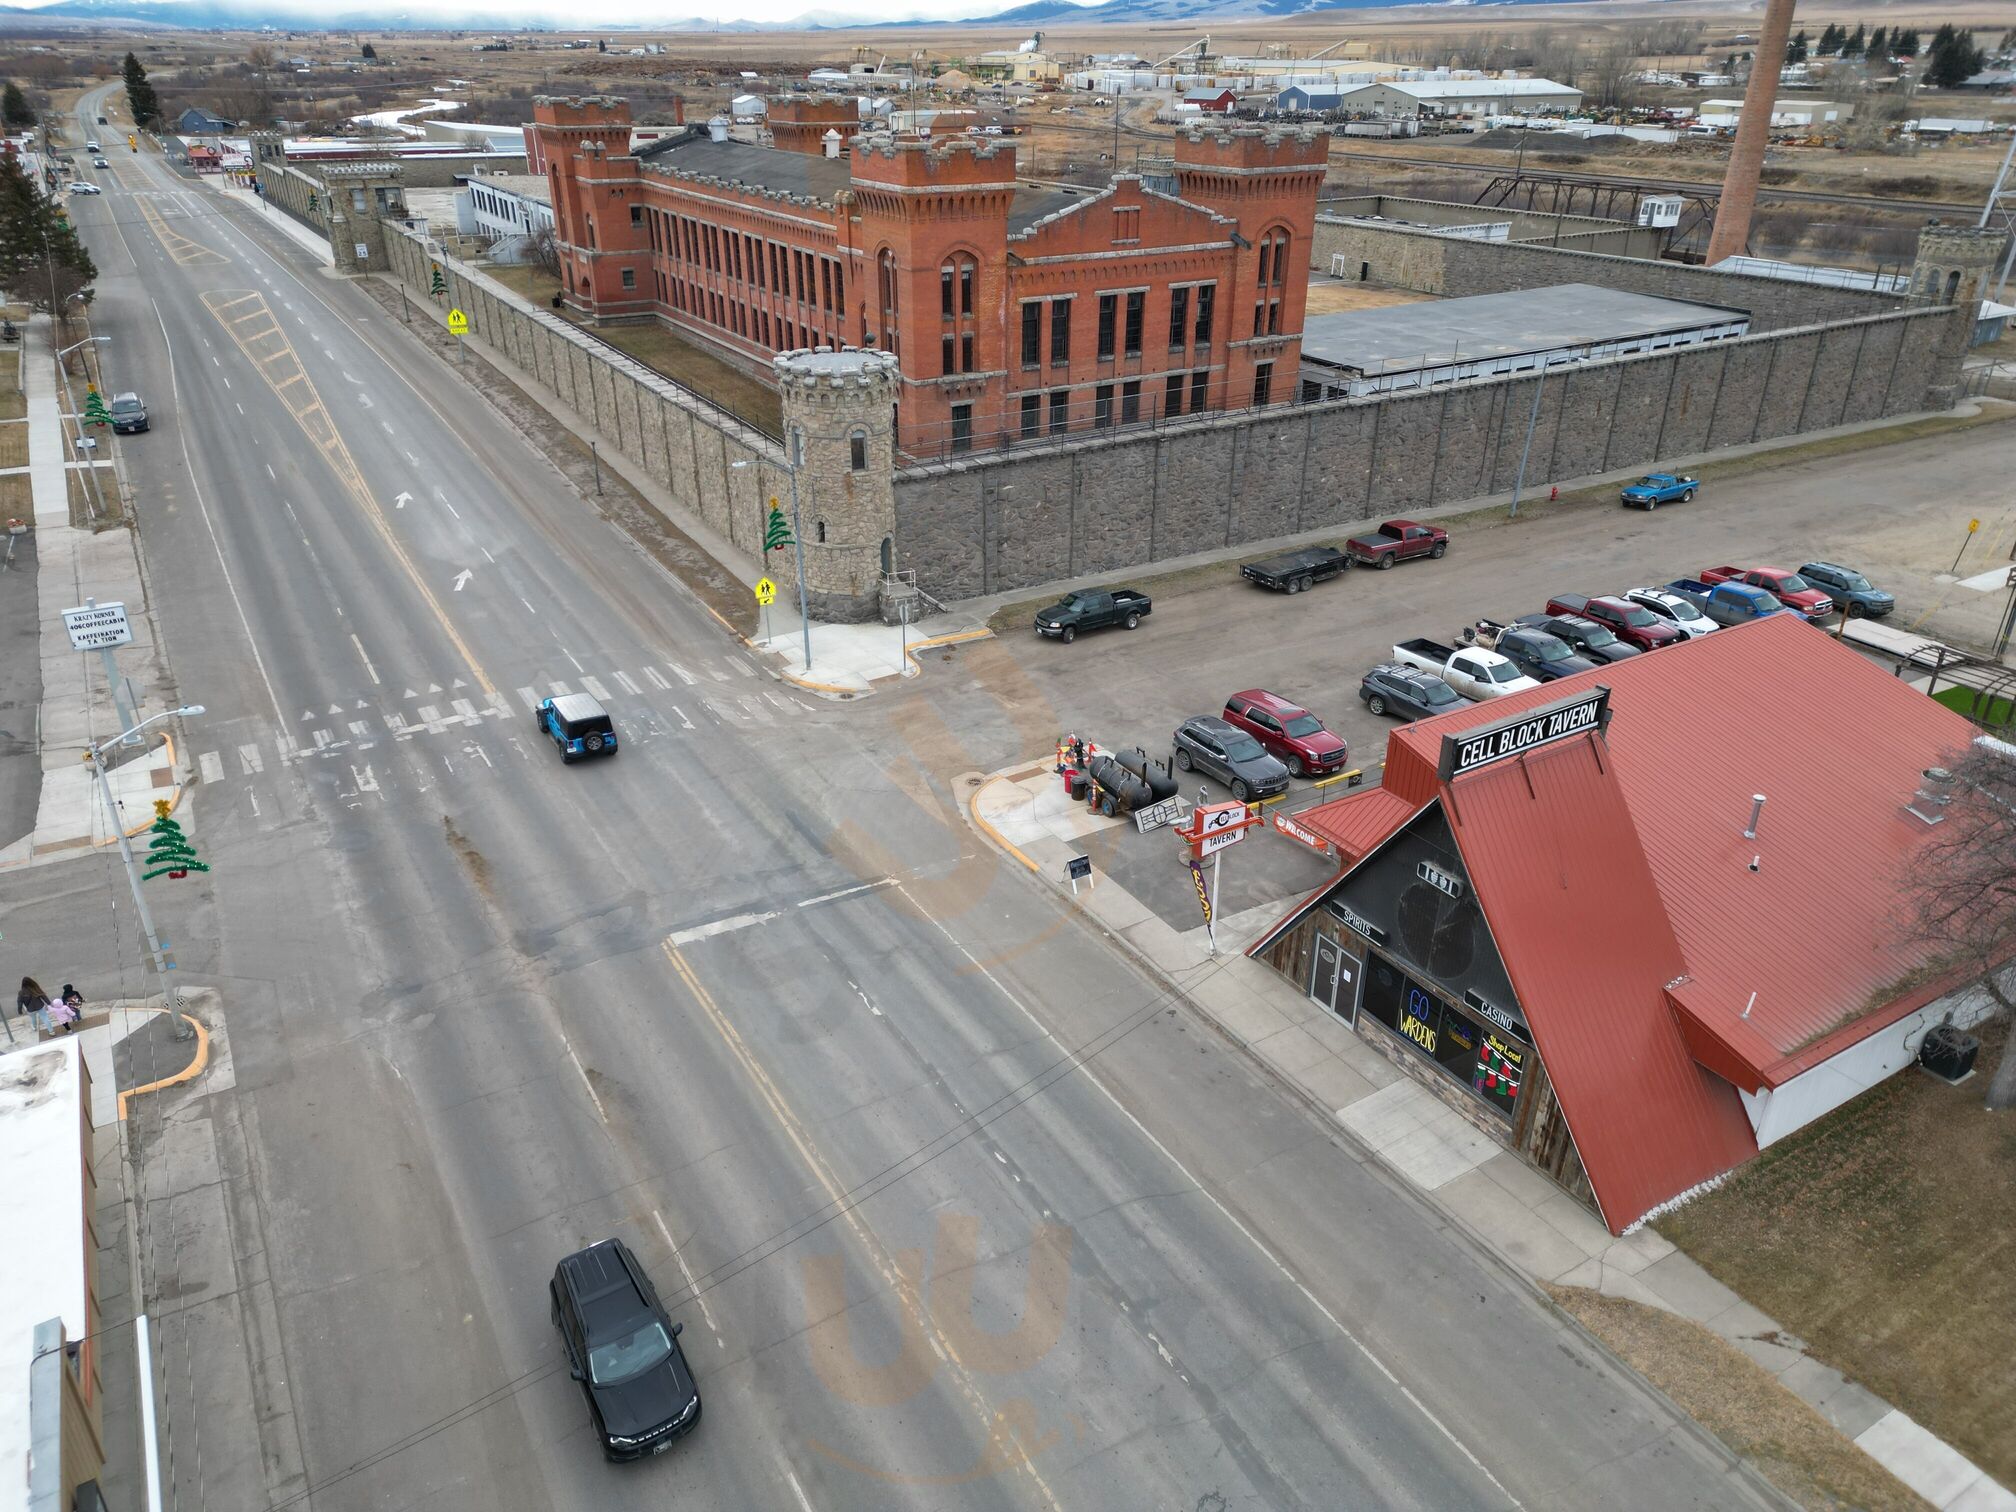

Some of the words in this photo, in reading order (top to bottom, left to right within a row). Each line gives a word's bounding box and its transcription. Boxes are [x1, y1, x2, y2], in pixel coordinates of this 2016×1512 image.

[73, 613, 94, 622] KRAZY
[94, 610, 116, 619] KORNER
[77, 628, 125, 641] KAFFEINATION
[1460, 736, 1496, 767] CELL
[1498, 718, 1548, 753] BLOCK
[1548, 700, 1599, 737] TAVERN
[1209, 831, 1237, 847] TAVERN
[1285, 819, 1316, 846] WELCOME
[1343, 910, 1371, 936] SPIRITS
[1409, 989, 1429, 1021] GO
[1480, 1001, 1513, 1030] CASINO
[1400, 1008, 1437, 1053] WARDENS
[1488, 1034, 1505, 1053] Shop
[1503, 1045, 1522, 1064] Local
